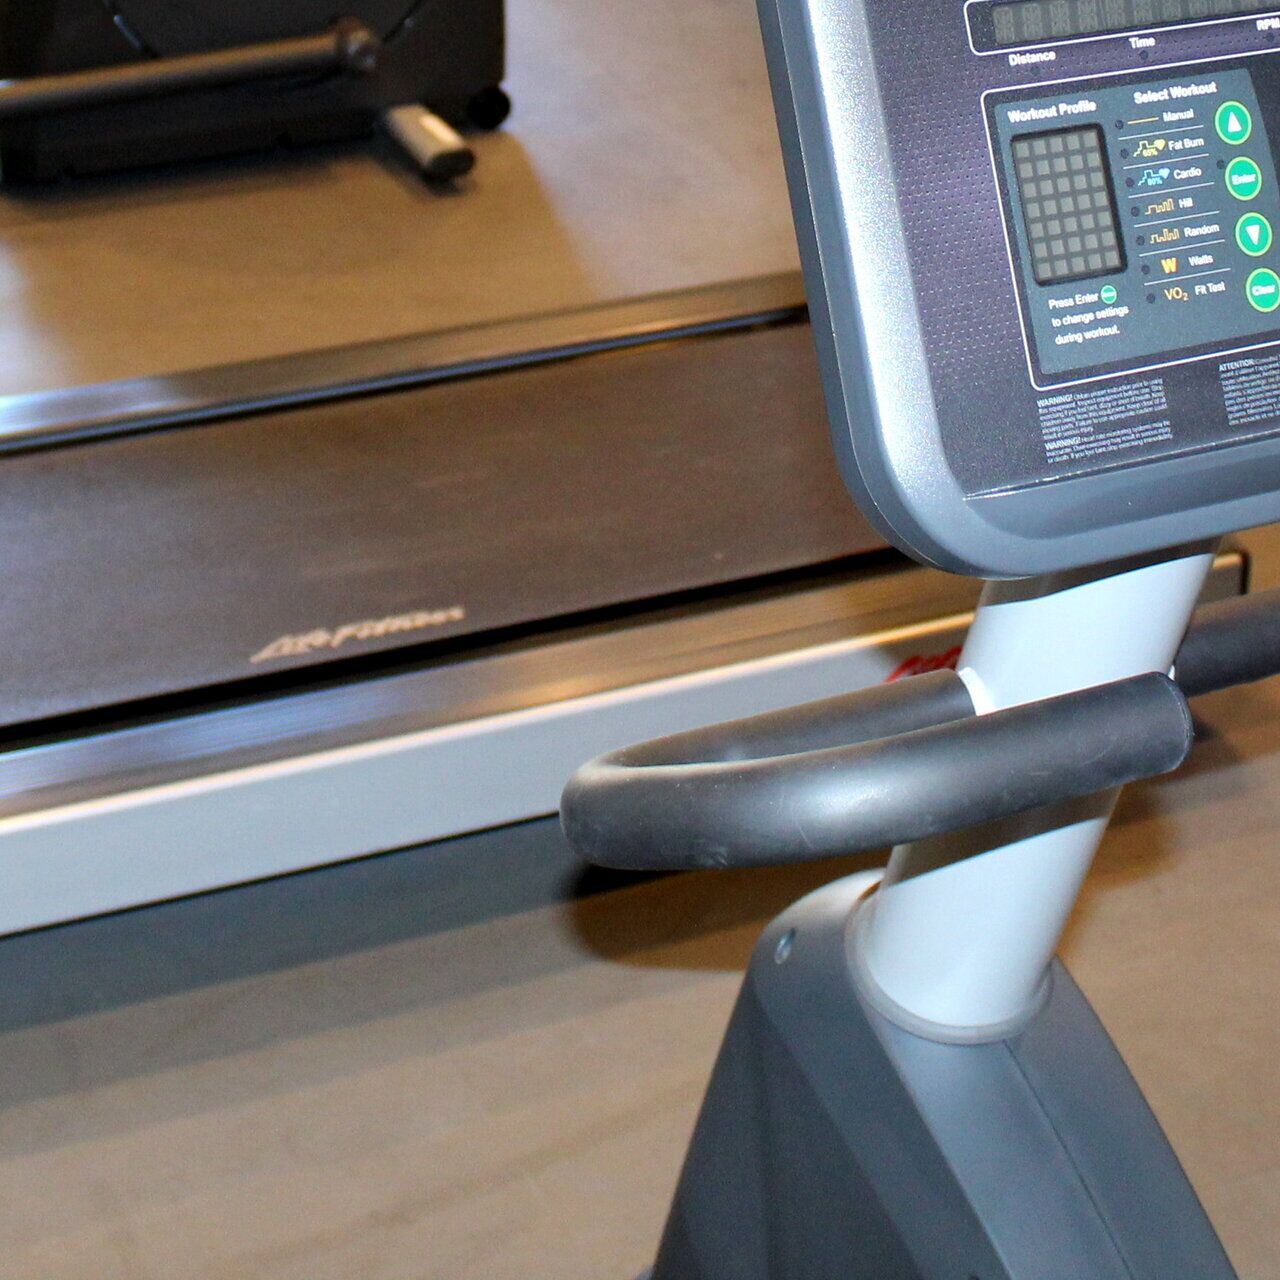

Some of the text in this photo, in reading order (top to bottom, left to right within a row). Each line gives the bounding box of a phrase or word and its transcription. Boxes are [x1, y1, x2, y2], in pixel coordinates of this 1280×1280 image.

[1256, 18, 1280, 31] RPM
[1129, 36, 1156, 49] Time
[1008, 50, 1056, 66] Distance
[1133, 82, 1218, 104] Select Workout
[1007, 100, 1097, 123] Workout Profile
[1162, 109, 1194, 122] Manual
[1168, 139, 1184, 151] Fat
[1184, 137, 1204, 149] Burn
[1173, 167, 1202, 180] Cardio
[1231, 173, 1256, 185] Enter
[1178, 198, 1194, 208] Hill
[1183, 224, 1220, 238] Random
[1161, 254, 1214, 274] W Watts
[1195, 284, 1208, 296] Fit
[1207, 281, 1226, 293] Test
[1048, 298, 1075, 310] Press
[1075, 292, 1099, 305] Enter
[1051, 306, 1129, 327] to change settings
[1055, 324, 1120, 345] during workout.
